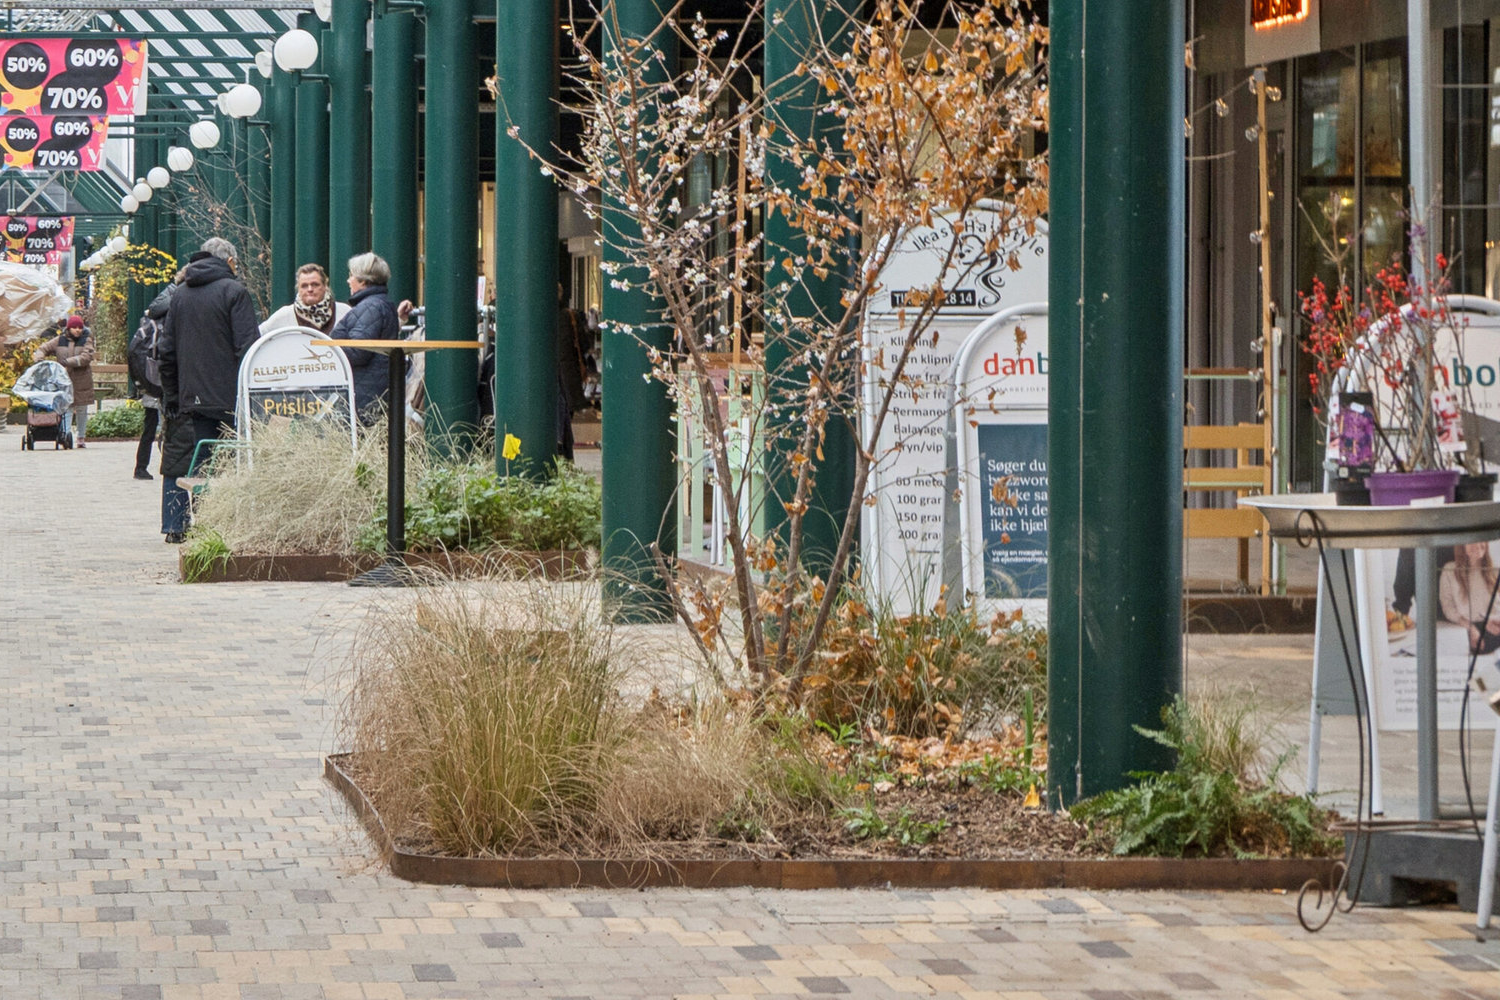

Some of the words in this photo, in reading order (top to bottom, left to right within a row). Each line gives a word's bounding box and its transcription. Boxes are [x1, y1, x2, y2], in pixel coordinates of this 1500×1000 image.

[70, 48, 119, 67] 60%
[7, 57, 47, 72] 50%
[47, 87, 102, 109] 70%
[8, 128, 37, 140] 50%
[54, 122, 90, 136] 60%
[38, 150, 78, 166] 70%
[38, 219, 61, 229] 60%
[27, 238, 55, 249] 70%
[24, 254, 46, 263] 70%
[960, 292, 972, 304] 14
[987, 459, 1026, 475] Søger
[1029, 459, 1047, 472] du
[897, 495, 916, 505] 100
[990, 504, 1013, 517] kan
[1017, 504, 1028, 517] vi
[898, 512, 918, 522] 150
[920, 514, 941, 525] gra
[990, 519, 1017, 532] ikke
